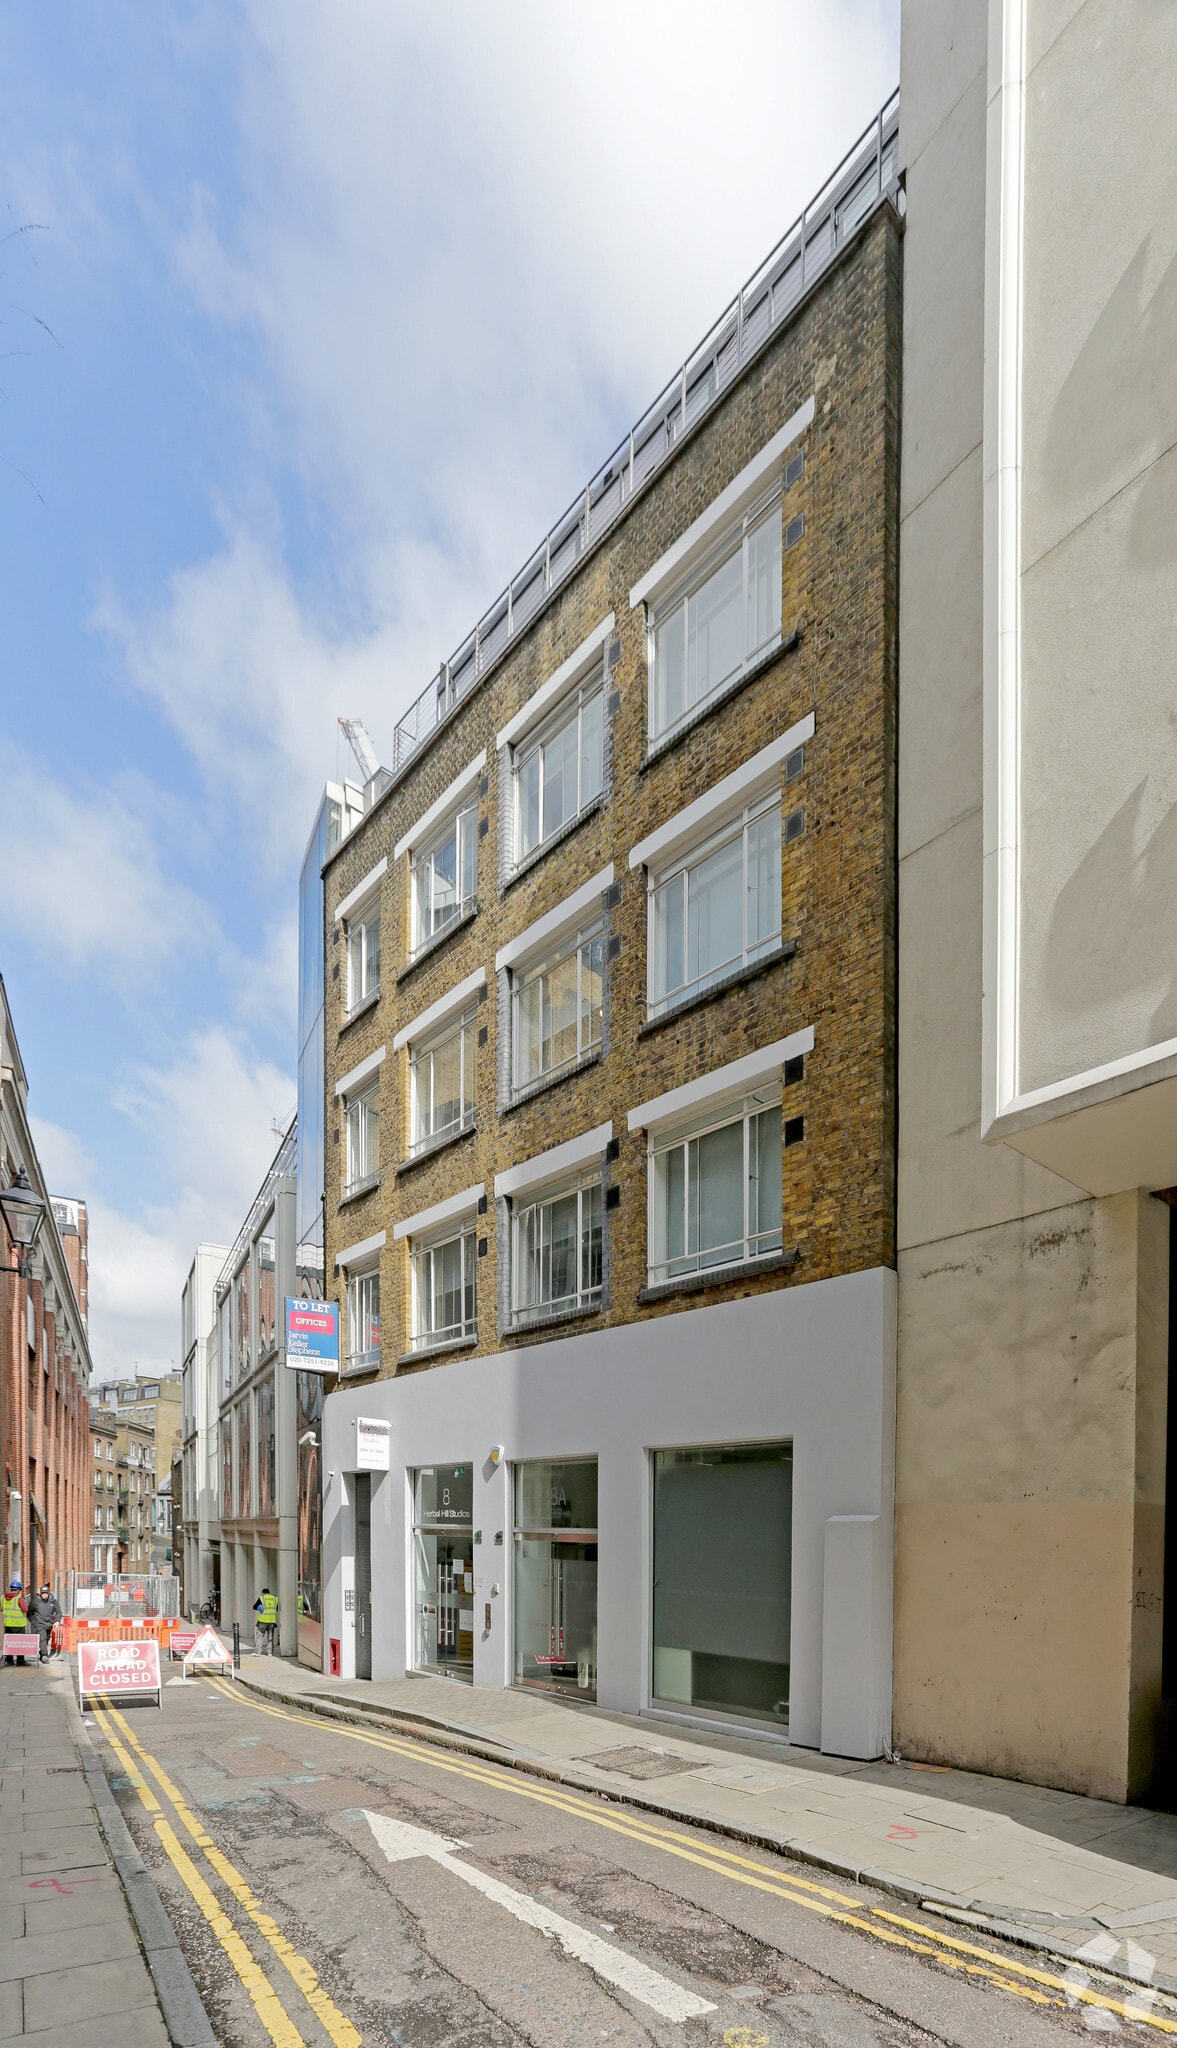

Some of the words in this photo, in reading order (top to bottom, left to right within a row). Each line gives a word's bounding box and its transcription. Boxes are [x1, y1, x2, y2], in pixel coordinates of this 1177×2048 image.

[292, 1300, 308, 1310] TO
[311, 1304, 330, 1313] LET
[295, 1317, 327, 1327] OFFICES
[288, 1331, 308, 1339] Jarvis
[442, 1488, 450, 1505] 8
[449, 1509, 470, 1518] Studios
[98, 1647, 140, 1659] ROAD
[94, 1660, 146, 1672] AHEAD
[89, 1672, 151, 1686] CLOSED
